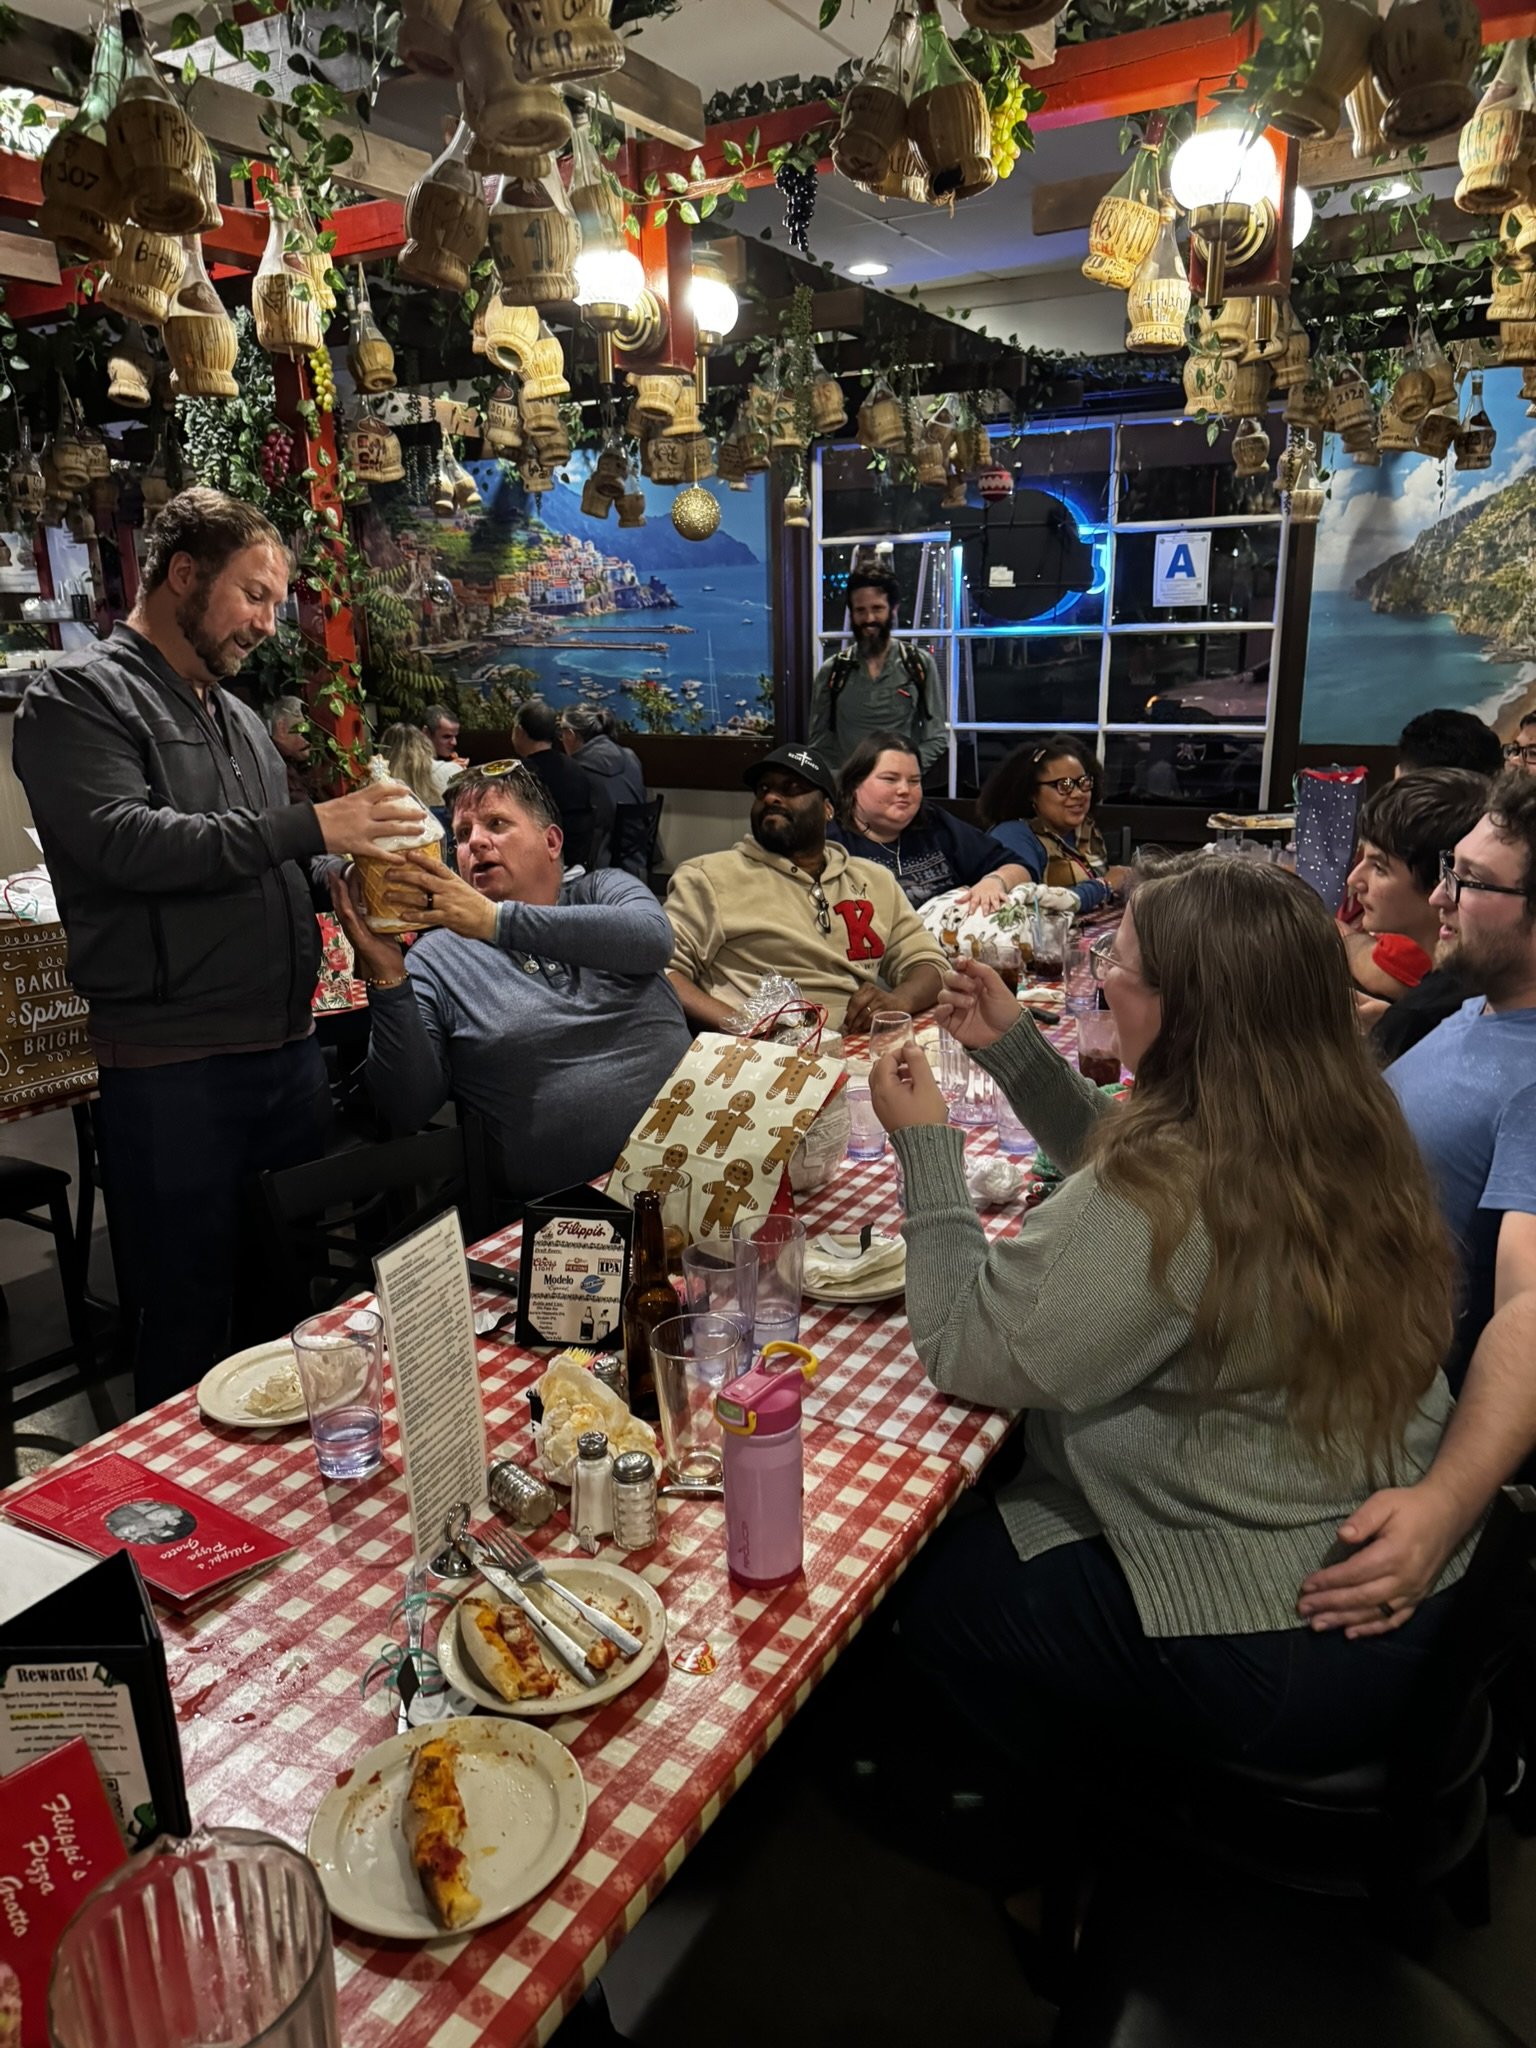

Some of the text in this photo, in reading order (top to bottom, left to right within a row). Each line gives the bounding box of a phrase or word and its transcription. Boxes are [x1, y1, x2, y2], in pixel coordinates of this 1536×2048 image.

[1166, 544, 1196, 579] A
[19, 995, 90, 1033] Spirits
[557, 1220, 606, 1239] Filippi's
[600, 1261, 620, 1273] IPA
[544, 1274, 574, 1286] Modelo
[160, 1538, 200, 1560] Grotto
[187, 1541, 228, 1561] Pizza
[197, 1542, 256, 1570] Filippi's
[16, 1666, 89, 1683] Rewards!
[42, 1793, 93, 1882] Filippi's
[22, 1835, 56, 1896] Pizza
[0, 1876, 30, 1938] Grotto
